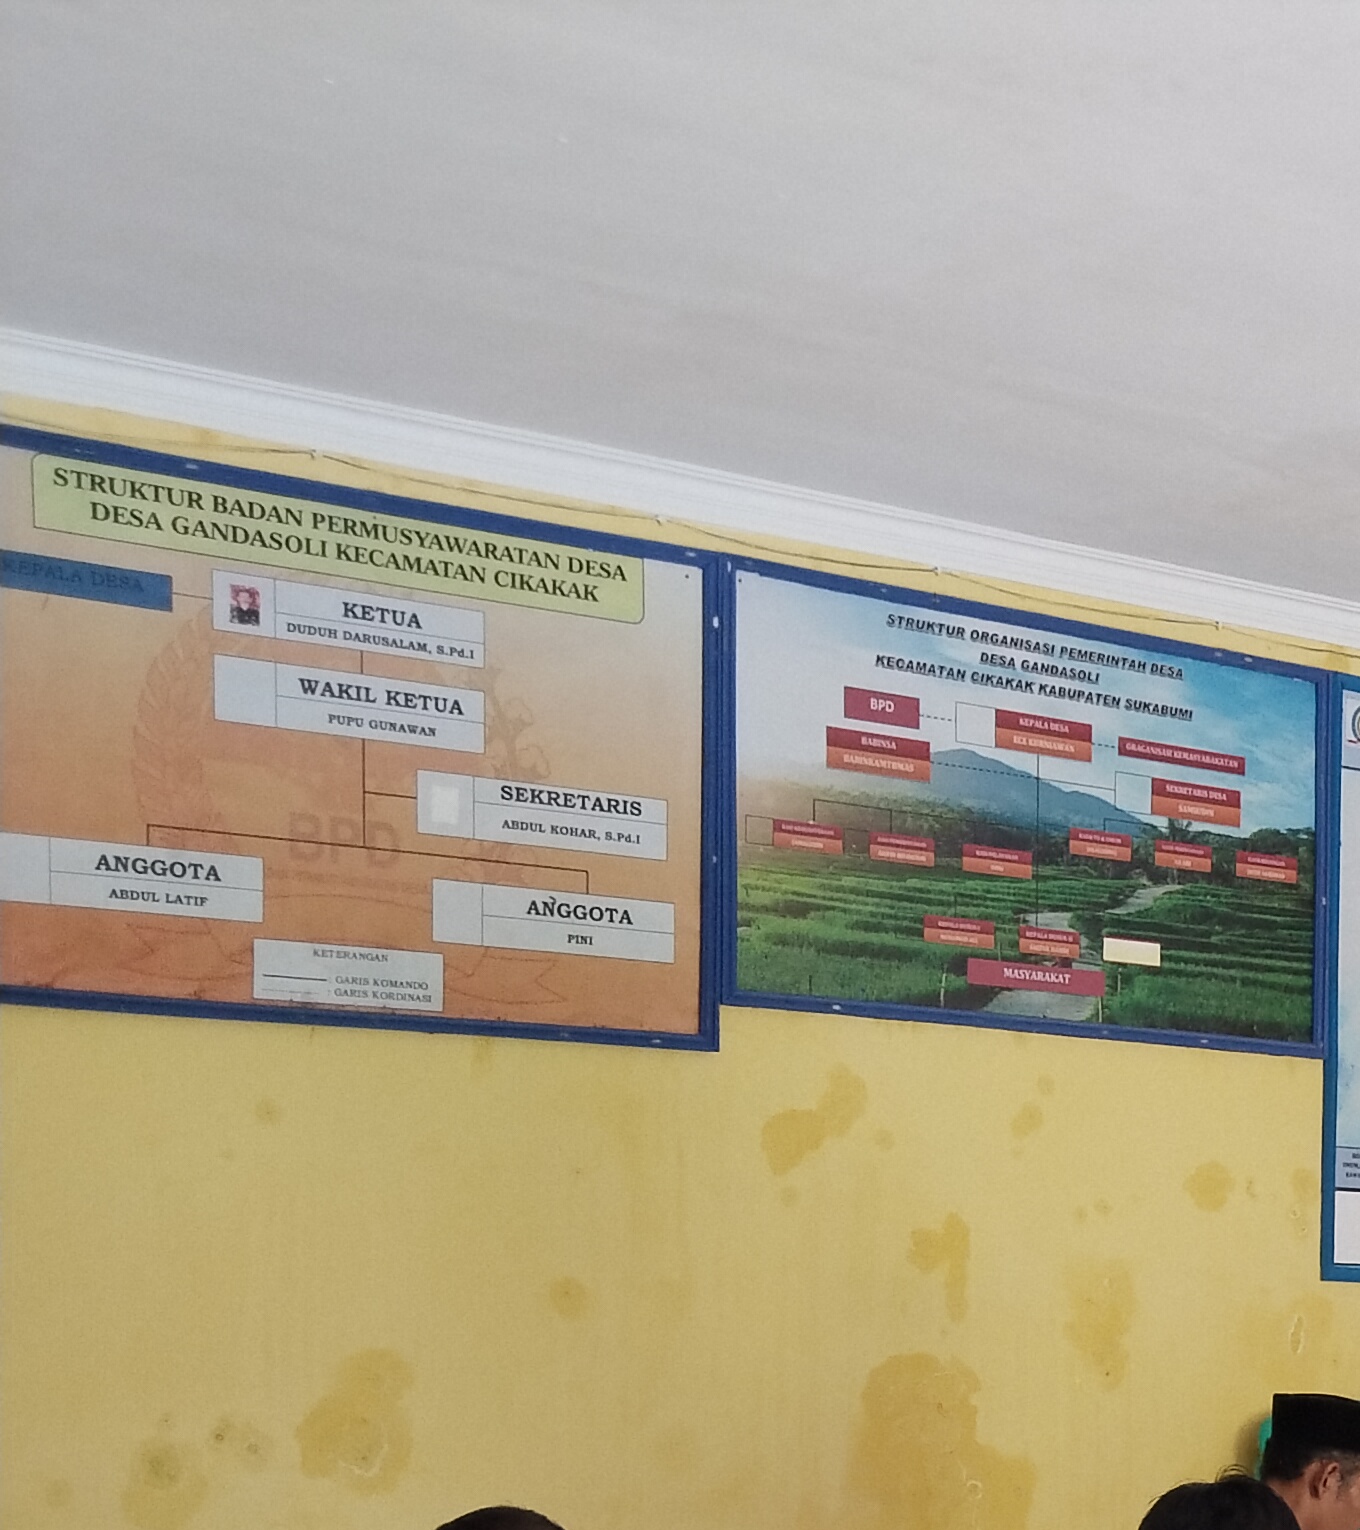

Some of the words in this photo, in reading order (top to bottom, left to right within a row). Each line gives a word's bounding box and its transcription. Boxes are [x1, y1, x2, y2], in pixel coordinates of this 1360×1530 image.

[53, 467, 205, 511] STRUKTUR
[211, 494, 303, 527] BADAN
[312, 512, 560, 570] PERMUSYAWARATAN
[567, 556, 628, 582] DESA
[90, 501, 163, 531] DESA
[172, 516, 328, 558] GANDASOLI
[336, 544, 486, 584] KECAMATAN
[493, 569, 599, 602] CIKAKAK
[2, 558, 81, 583] KEPALA
[90, 570, 145, 593] DESA
[342, 601, 423, 630] KETUA
[286, 621, 338, 640] DUDUH
[343, 630, 432, 655] DARUSALAM,
[436, 645, 475, 660] S.Pd.I
[887, 613, 966, 640] STRUKTUR
[970, 629, 1056, 655] ORGANISASI
[1060, 645, 1147, 672] PEMERINTAH
[1151, 661, 1184, 680] DESA
[980, 651, 1017, 670] DESA
[1020, 658, 1101, 685] GANDASOLI
[297, 678, 377, 704] WAKIL
[385, 689, 465, 716] KETUA
[875, 653, 967, 682] KECAMATAN
[970, 670, 1035, 694] CIKAKAK
[1038, 681, 1122, 709] KABUPATEN
[1125, 695, 1194, 721] SUKABUMI
[870, 698, 895, 713] BPD
[328, 713, 364, 729] PUPU
[369, 719, 437, 738] GUNAWAN
[500, 785, 643, 817] SEKRETARIS
[501, 819, 546, 834] ABDUL
[550, 824, 601, 841] KOHAR,
[605, 831, 641, 845] S.Pd.I
[94, 853, 222, 882] ANGGOTA
[108, 888, 160, 903] ABDUL
[165, 892, 209, 907] LATIF
[526, 900, 634, 925] ANGGOTA
[567, 934, 594, 946] PINI
[313, 948, 389, 963] KETERANGAN
[335, 975, 375, 987] GARIS
[378, 978, 429, 991] KOMANDO
[1003, 967, 1071, 985] MASYARAKAT
